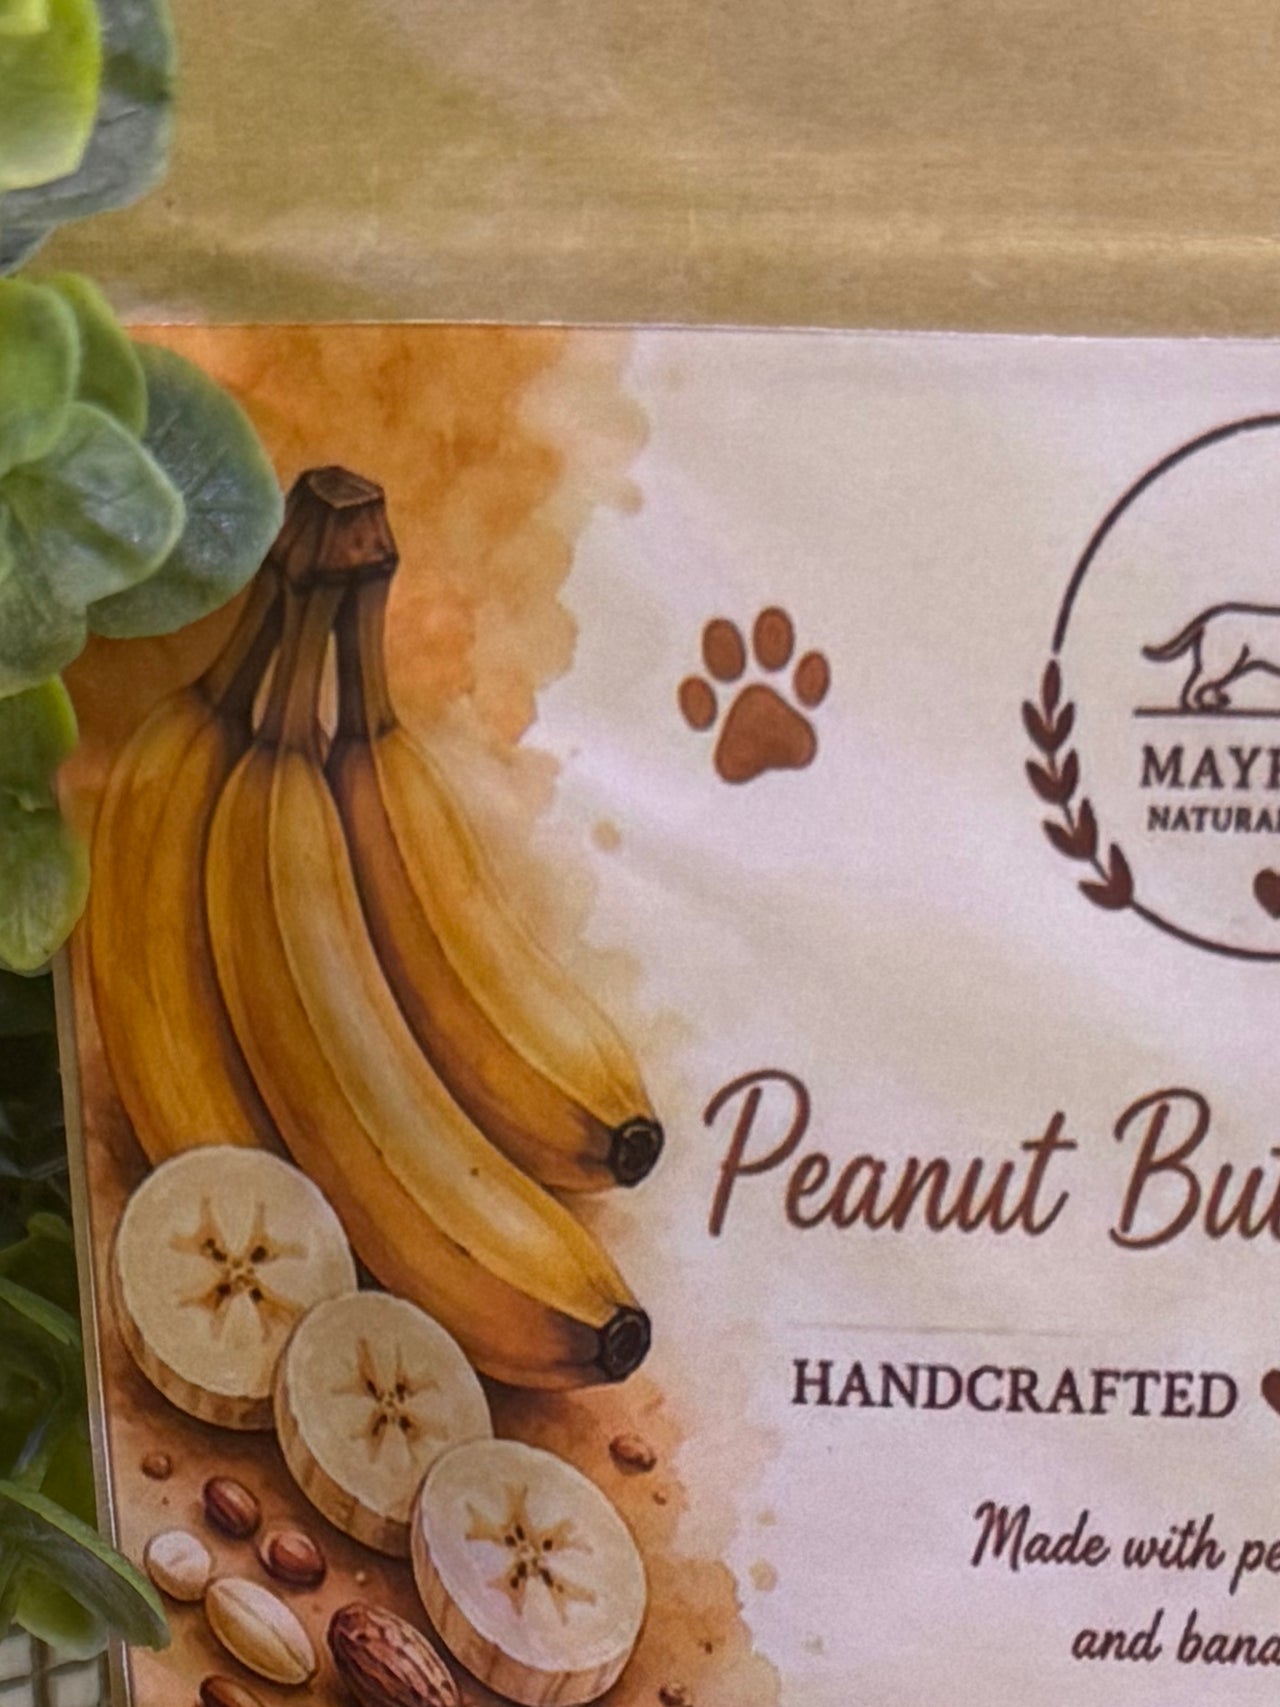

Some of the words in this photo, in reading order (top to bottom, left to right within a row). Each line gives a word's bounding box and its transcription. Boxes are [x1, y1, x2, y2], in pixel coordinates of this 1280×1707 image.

[703, 1068, 1078, 1238] Peanut
[791, 1358, 1239, 1420] HANDCRAFTED
[970, 1500, 1111, 1572] Made
[1122, 1514, 1225, 1573] with
[1071, 1608, 1163, 1663] and
